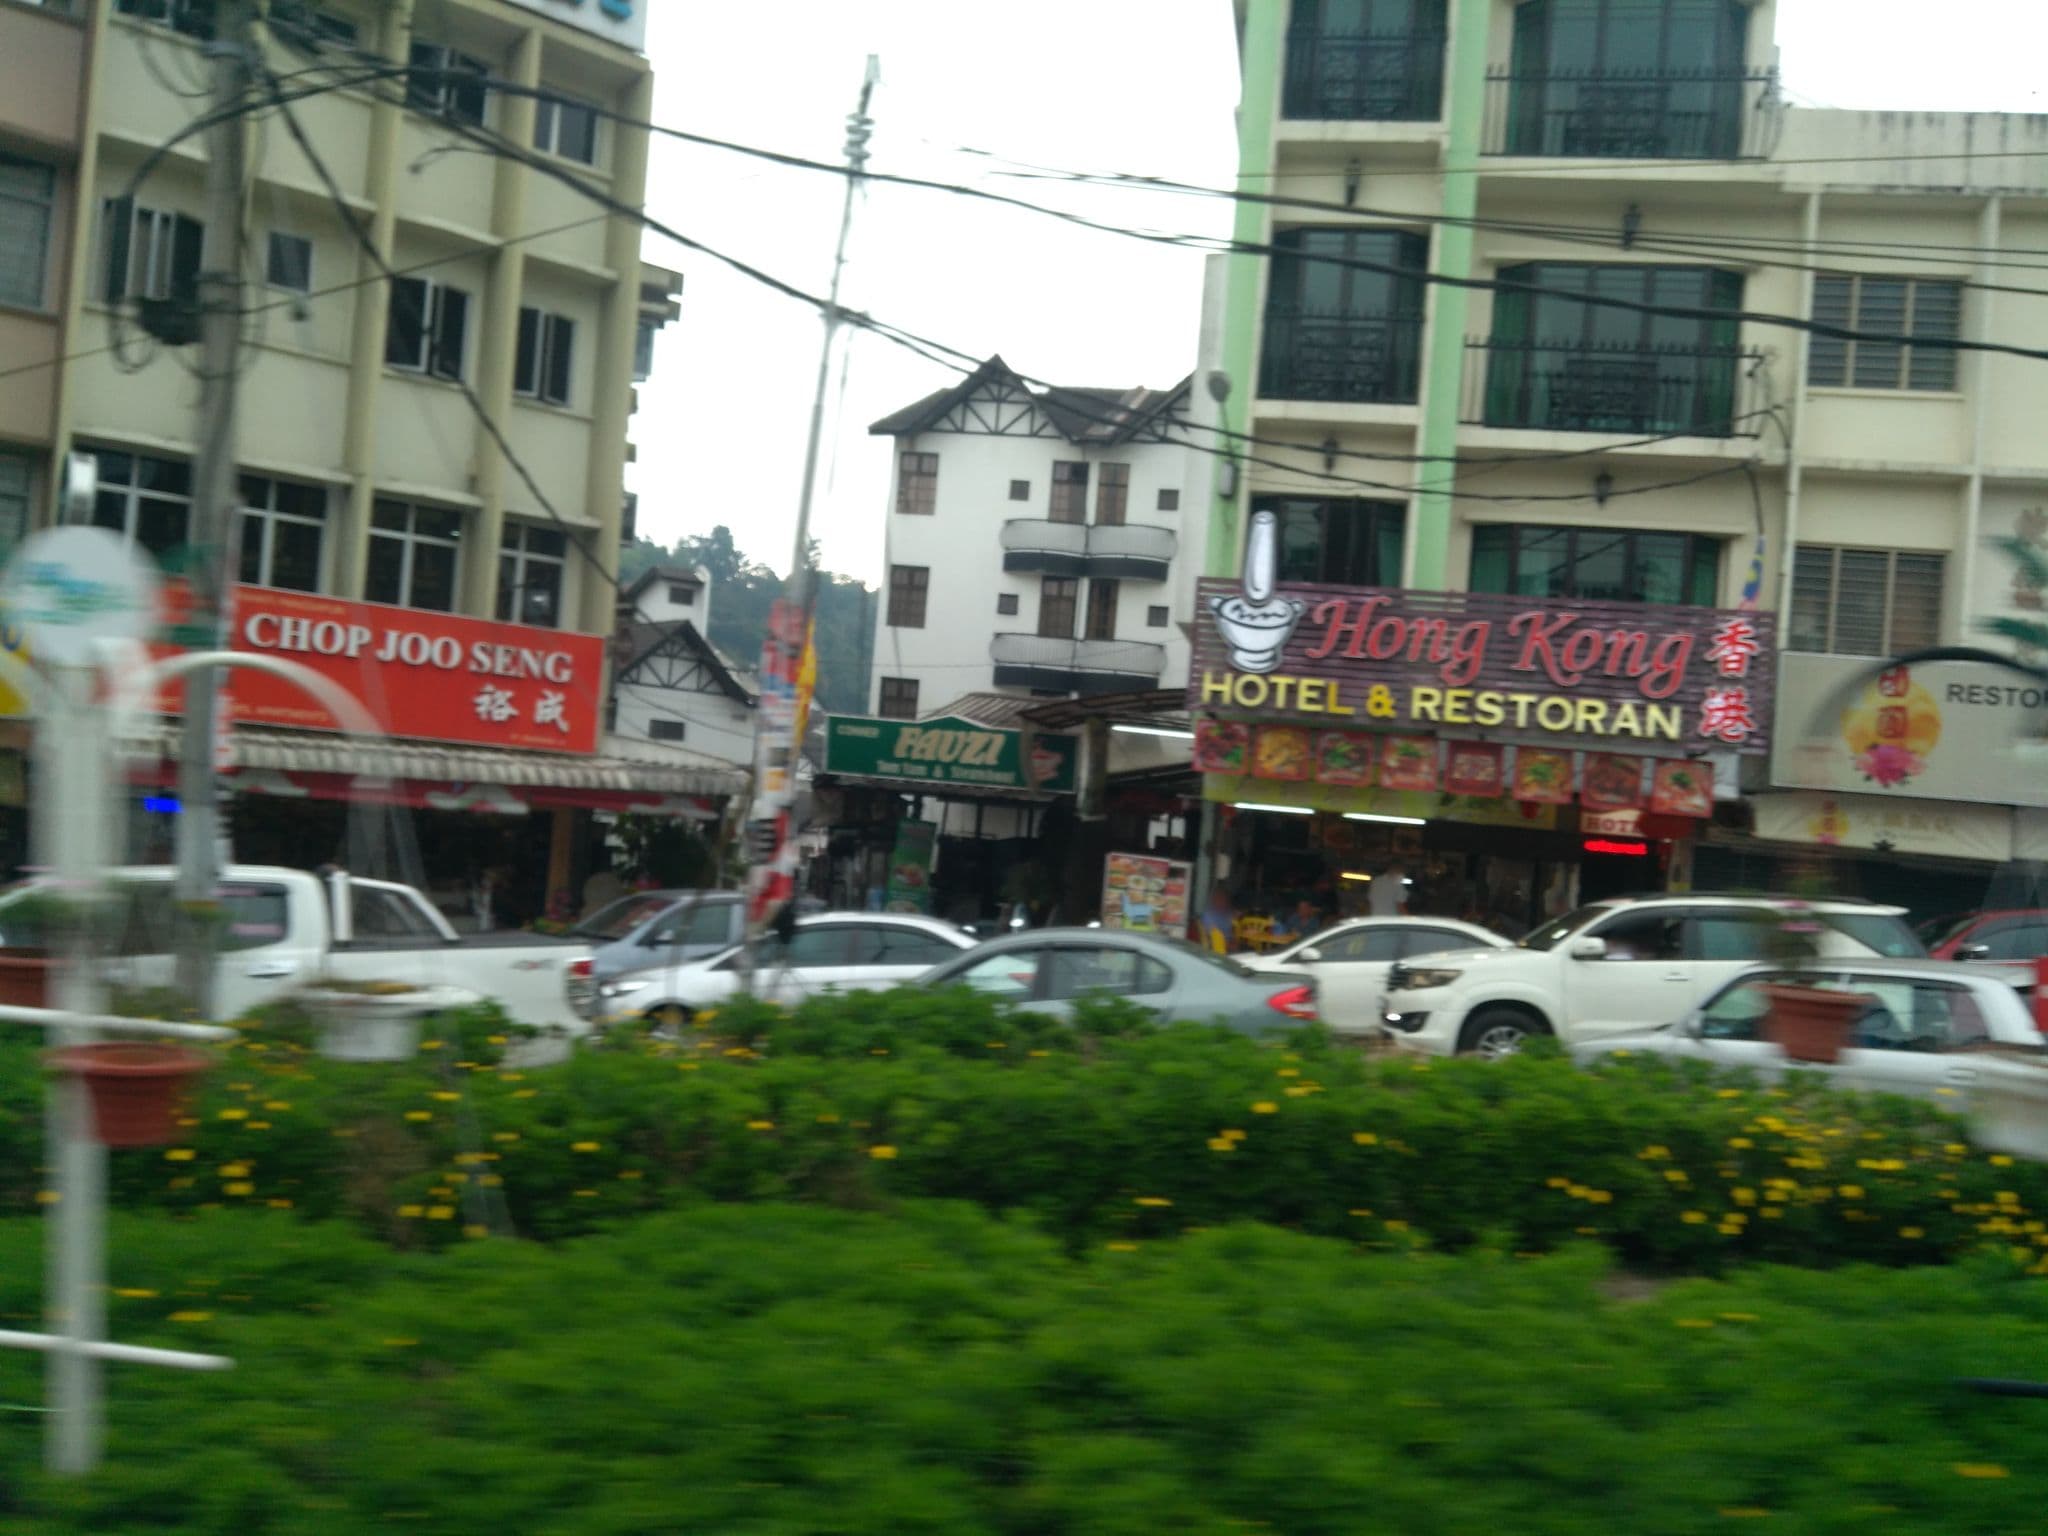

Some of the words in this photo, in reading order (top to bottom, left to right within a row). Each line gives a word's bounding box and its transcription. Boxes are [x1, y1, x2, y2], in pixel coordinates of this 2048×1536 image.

[245, 612, 373, 659] CHOP
[376, 629, 463, 670] JOO
[468, 640, 574, 685] SENG
[1305, 596, 1492, 687] Hong
[1507, 611, 1695, 699] Kong
[1699, 616, 1760, 743] 香港
[1202, 671, 1356, 716] HOTEL
[1365, 683, 1397, 718] &
[1411, 686, 1683, 740] RESTORAN
[893, 726, 1006, 767] FAUZI
